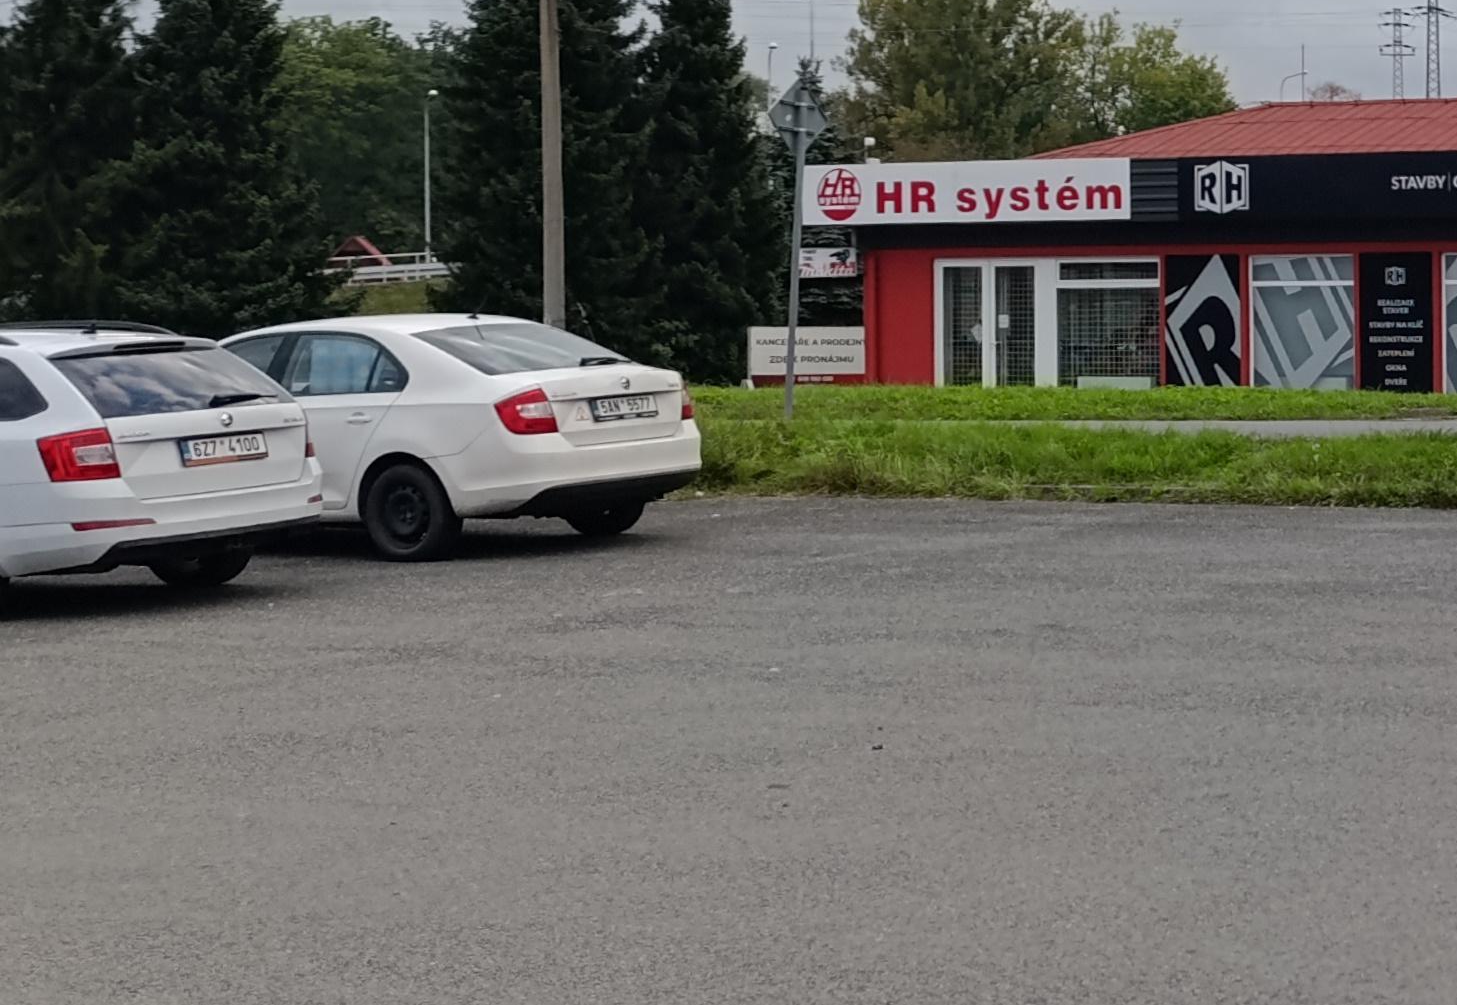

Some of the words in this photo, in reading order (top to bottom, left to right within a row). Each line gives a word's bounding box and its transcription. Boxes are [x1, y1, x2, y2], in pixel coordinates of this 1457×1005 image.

[1199, 167, 1244, 207] RH
[1391, 175, 1446, 190] STAVBY
[876, 181, 936, 213] HR
[956, 176, 1123, 219] systém
[801, 354, 855, 364] PRONÁJMU
[600, 397, 621, 414] 5AN
[626, 396, 651, 411] 5577
[193, 440, 217, 458] 6Z7
[228, 436, 260, 453] 4100
